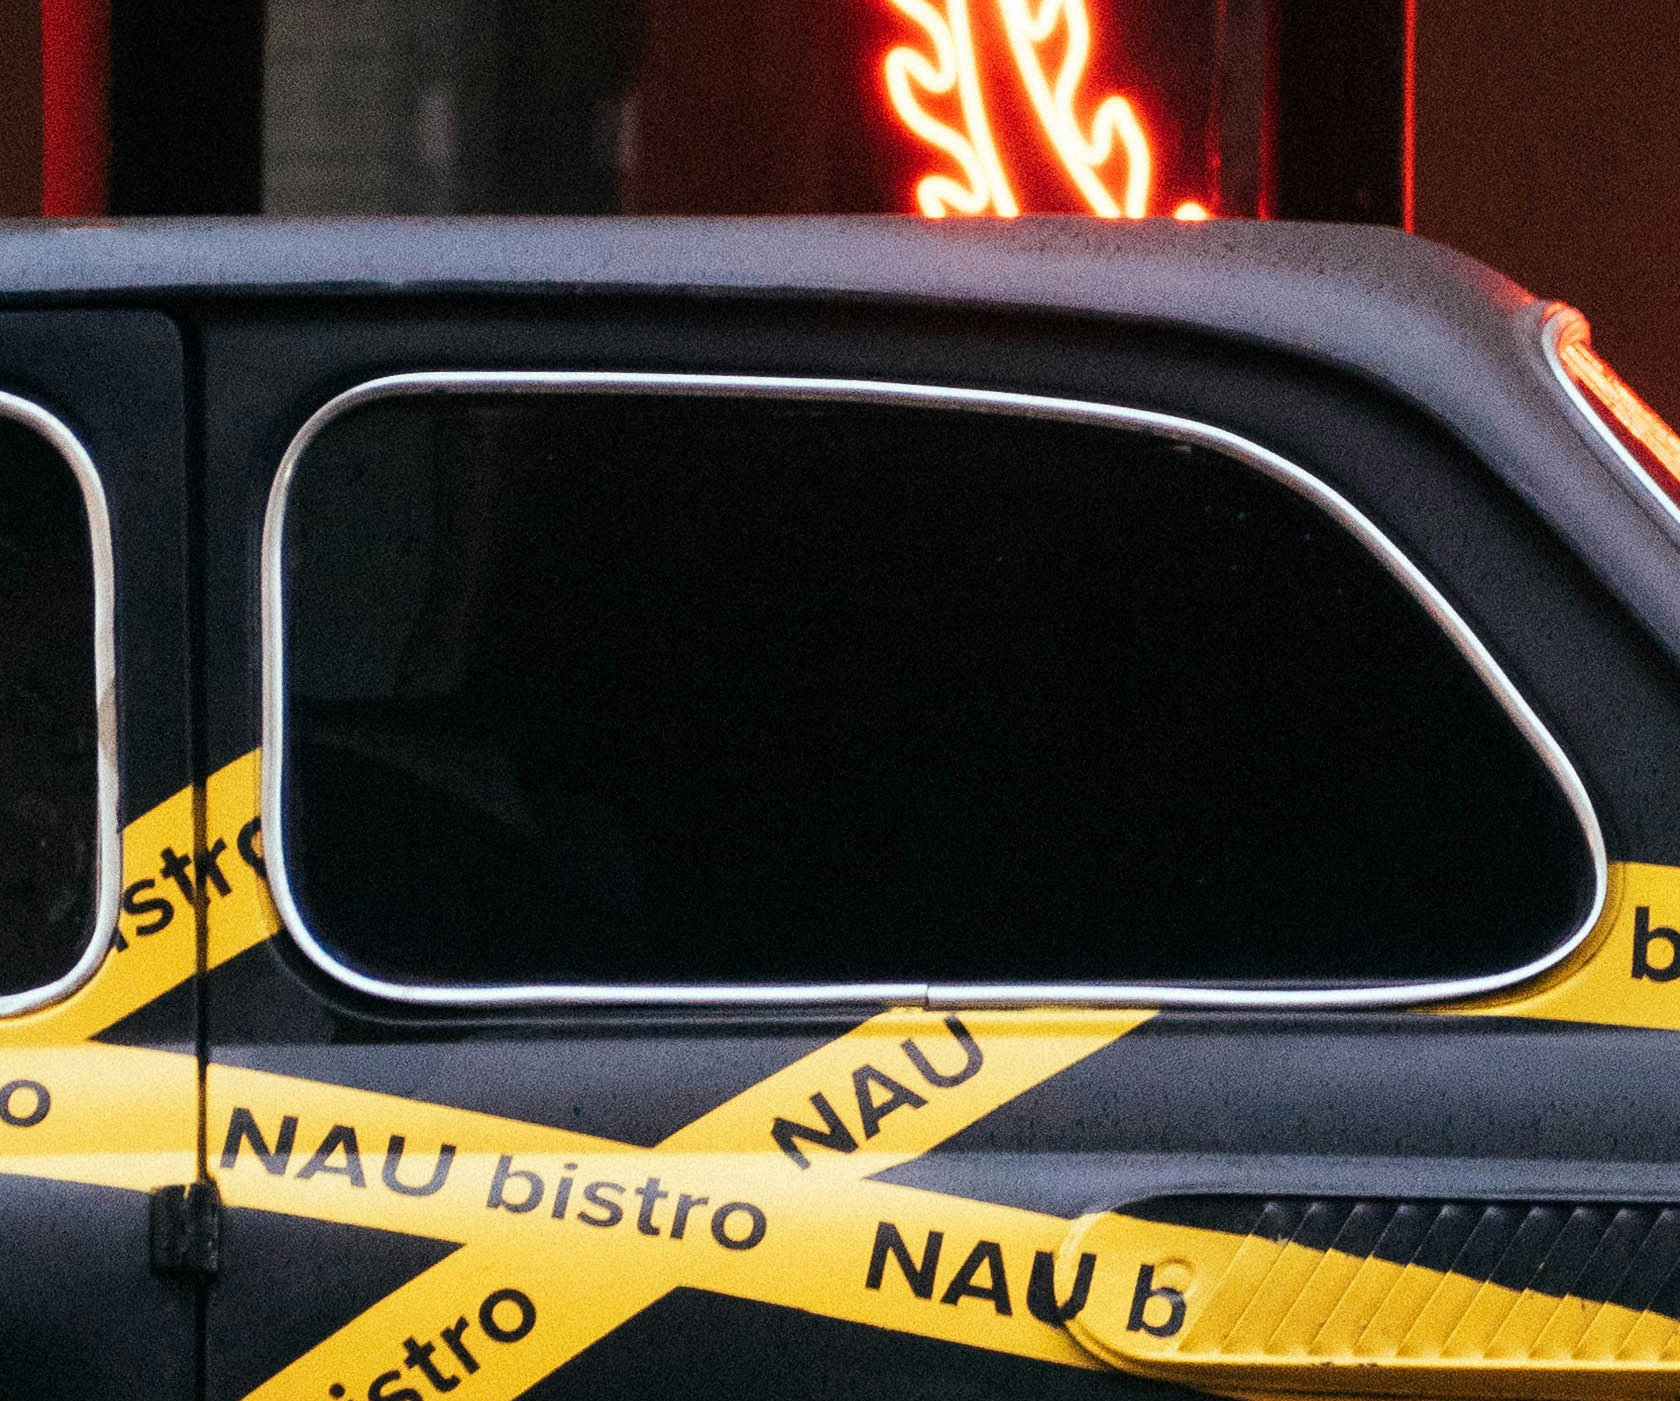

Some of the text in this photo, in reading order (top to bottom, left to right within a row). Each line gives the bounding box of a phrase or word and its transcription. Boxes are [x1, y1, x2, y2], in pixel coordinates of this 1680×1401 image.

[768, 1012, 985, 1170] NAU
[219, 1106, 457, 1197] NAU
[485, 1154, 768, 1252] bistro
[865, 1221, 1097, 1328] NAU
